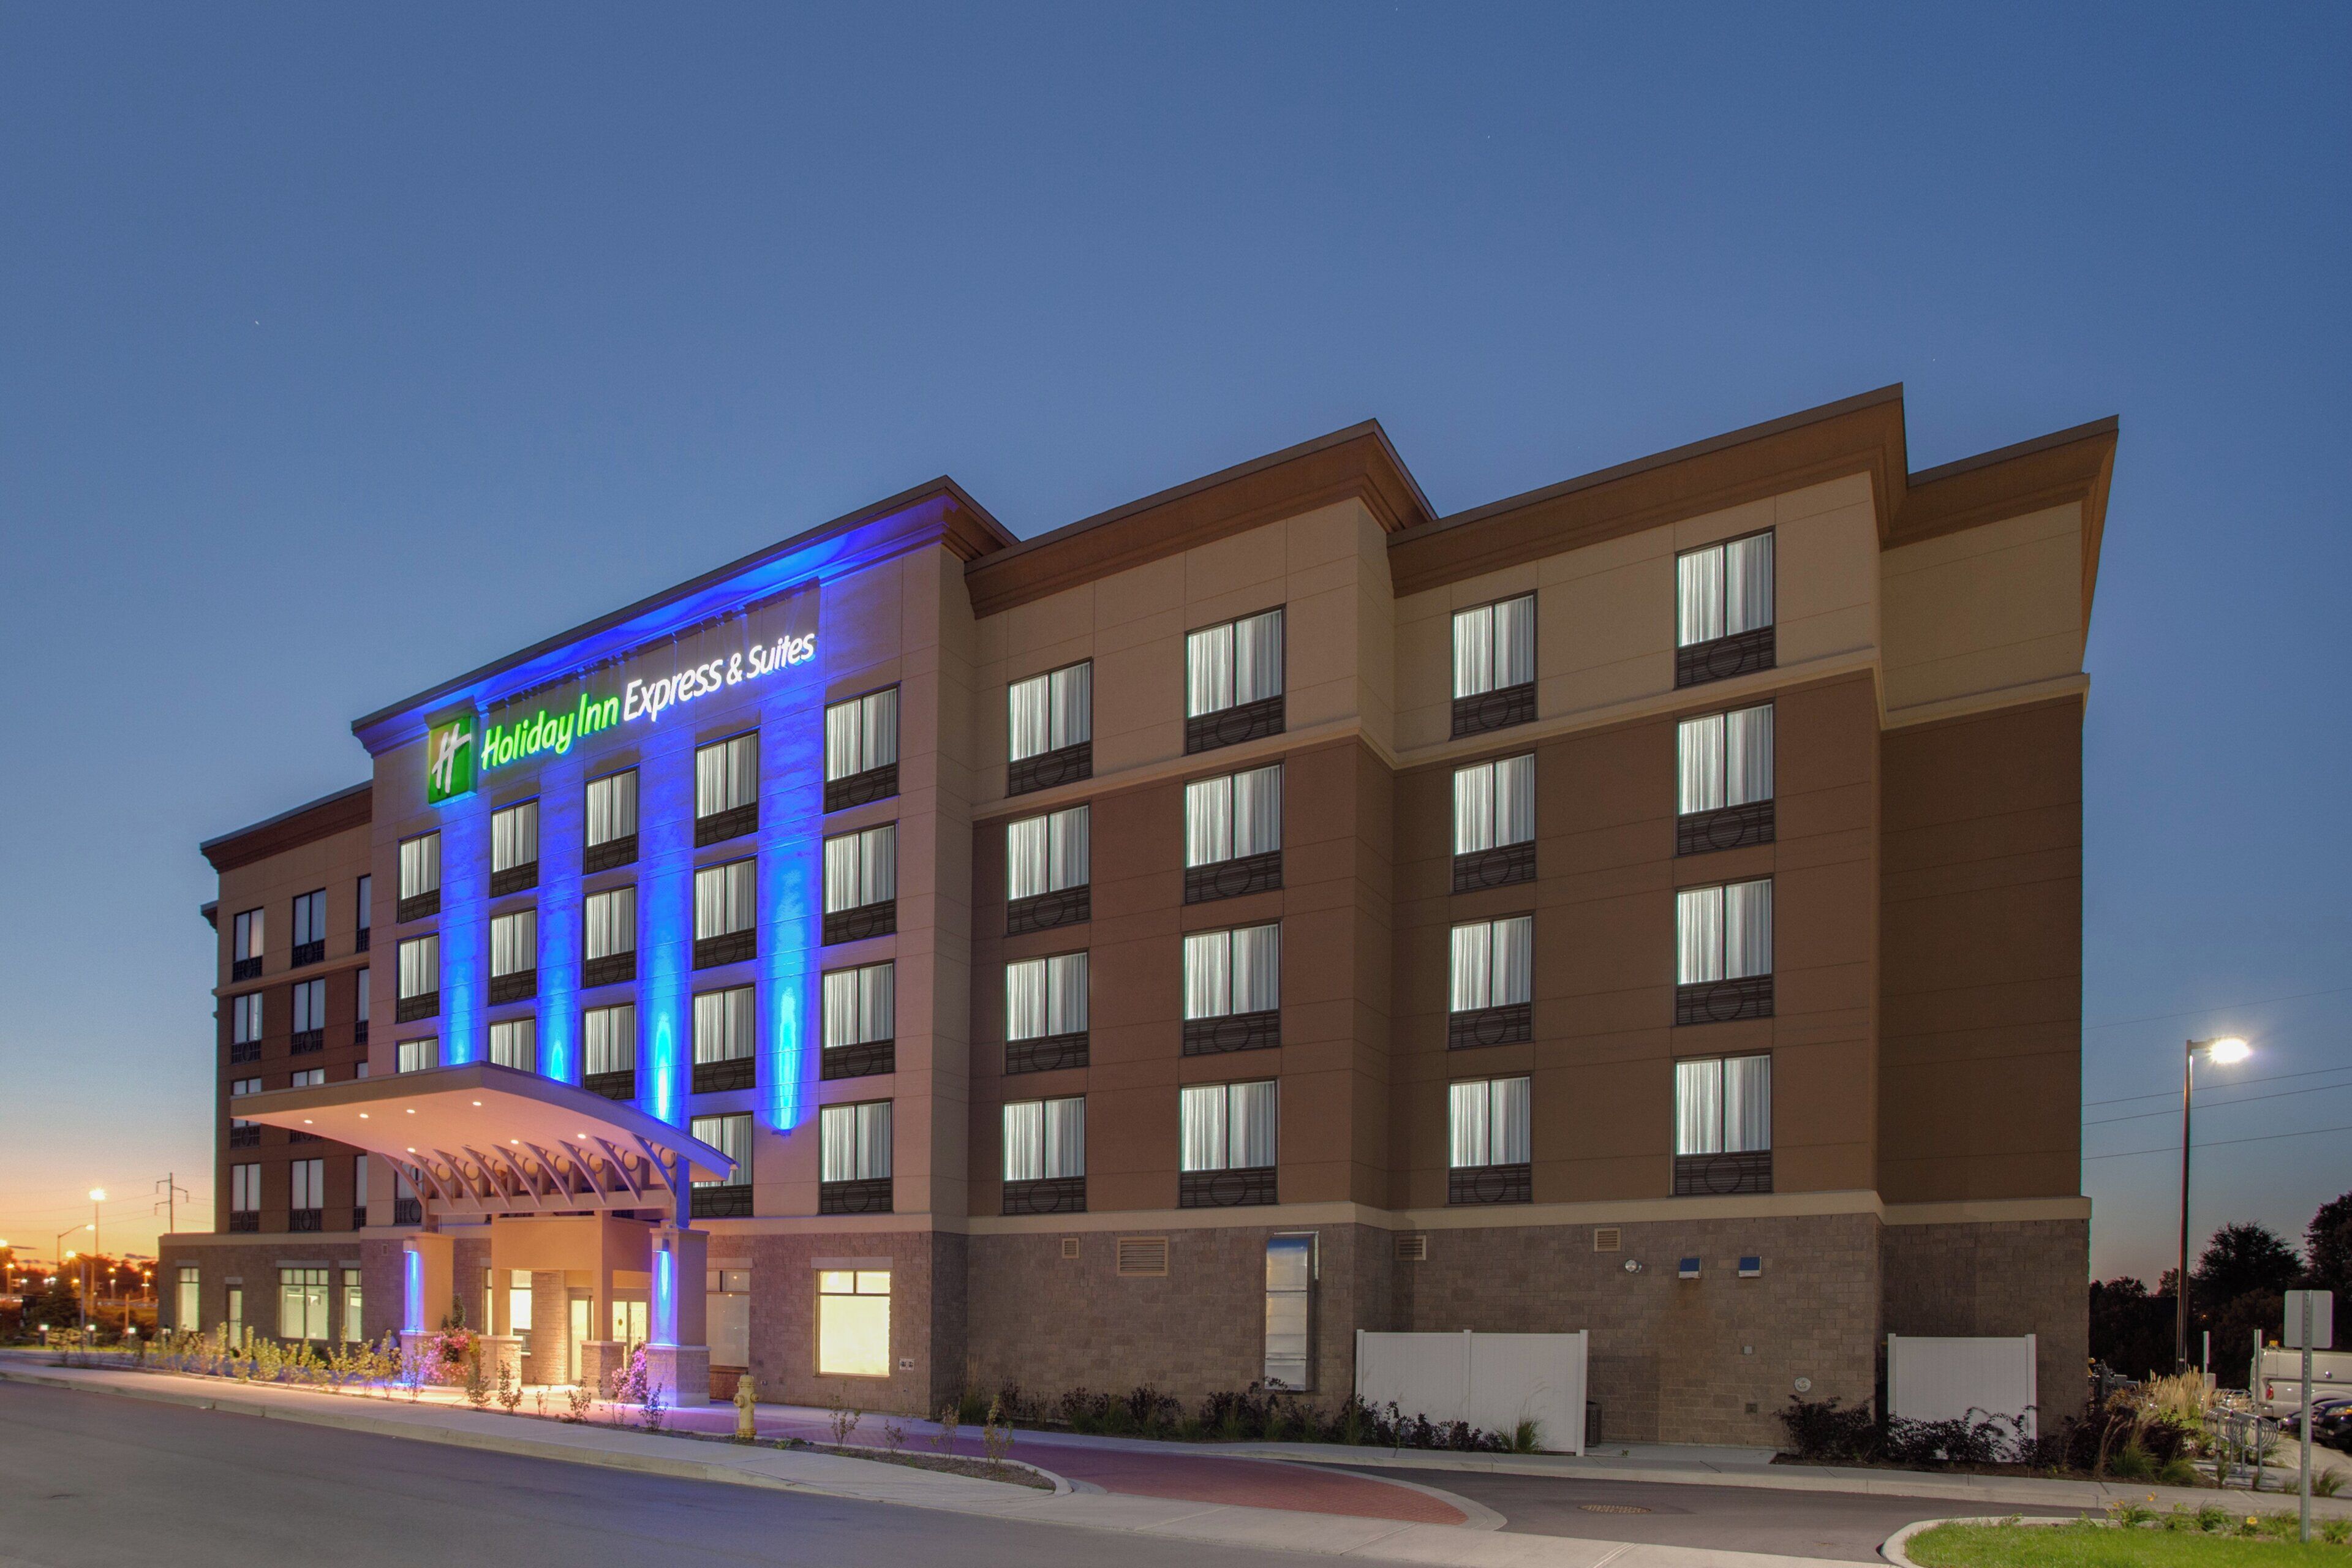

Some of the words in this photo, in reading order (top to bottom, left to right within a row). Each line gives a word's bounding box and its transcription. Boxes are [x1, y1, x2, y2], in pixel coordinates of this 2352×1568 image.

[481, 709, 575, 770] Holiday
[577, 693, 619, 737] Inn
[624, 658, 724, 722] Express
[726, 653, 743, 685] &
[747, 633, 815, 678] Suites
